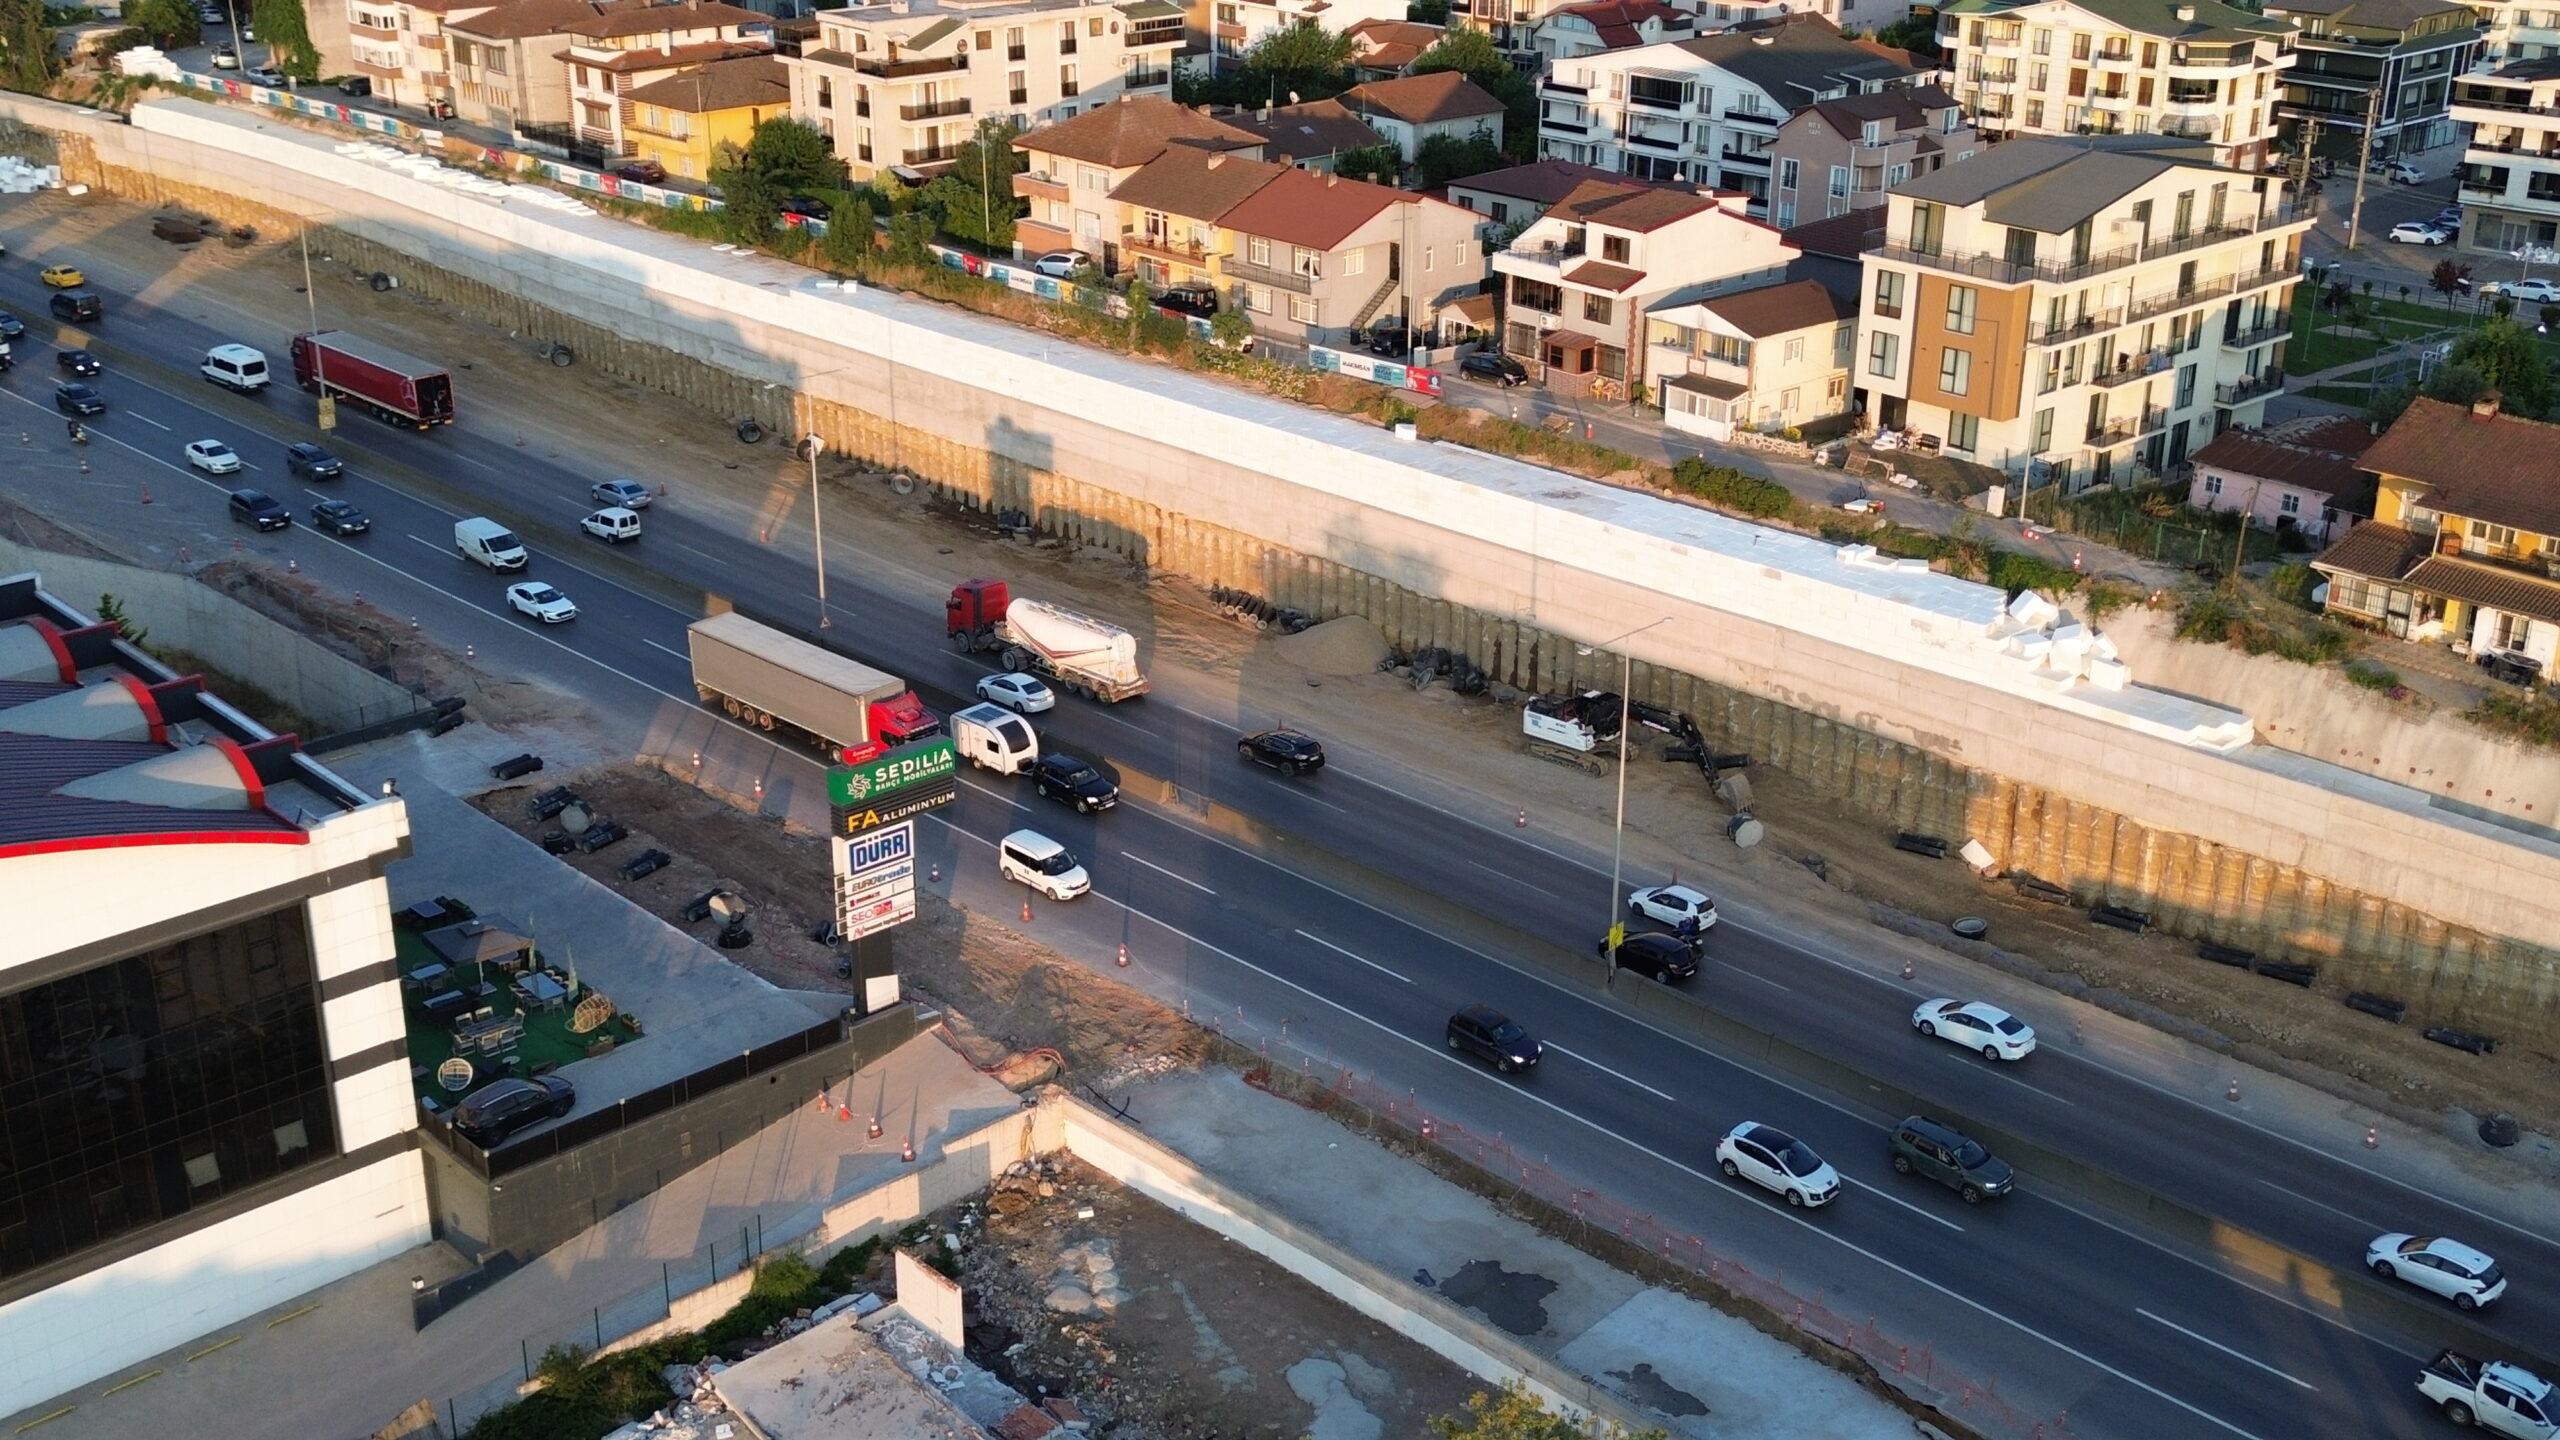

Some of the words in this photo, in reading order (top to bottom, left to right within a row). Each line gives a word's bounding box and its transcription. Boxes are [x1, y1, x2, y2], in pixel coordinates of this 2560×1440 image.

[875, 778, 900, 791] BAHÇE
[848, 809, 880, 832] FA
[856, 834, 904, 867] DÜRR
